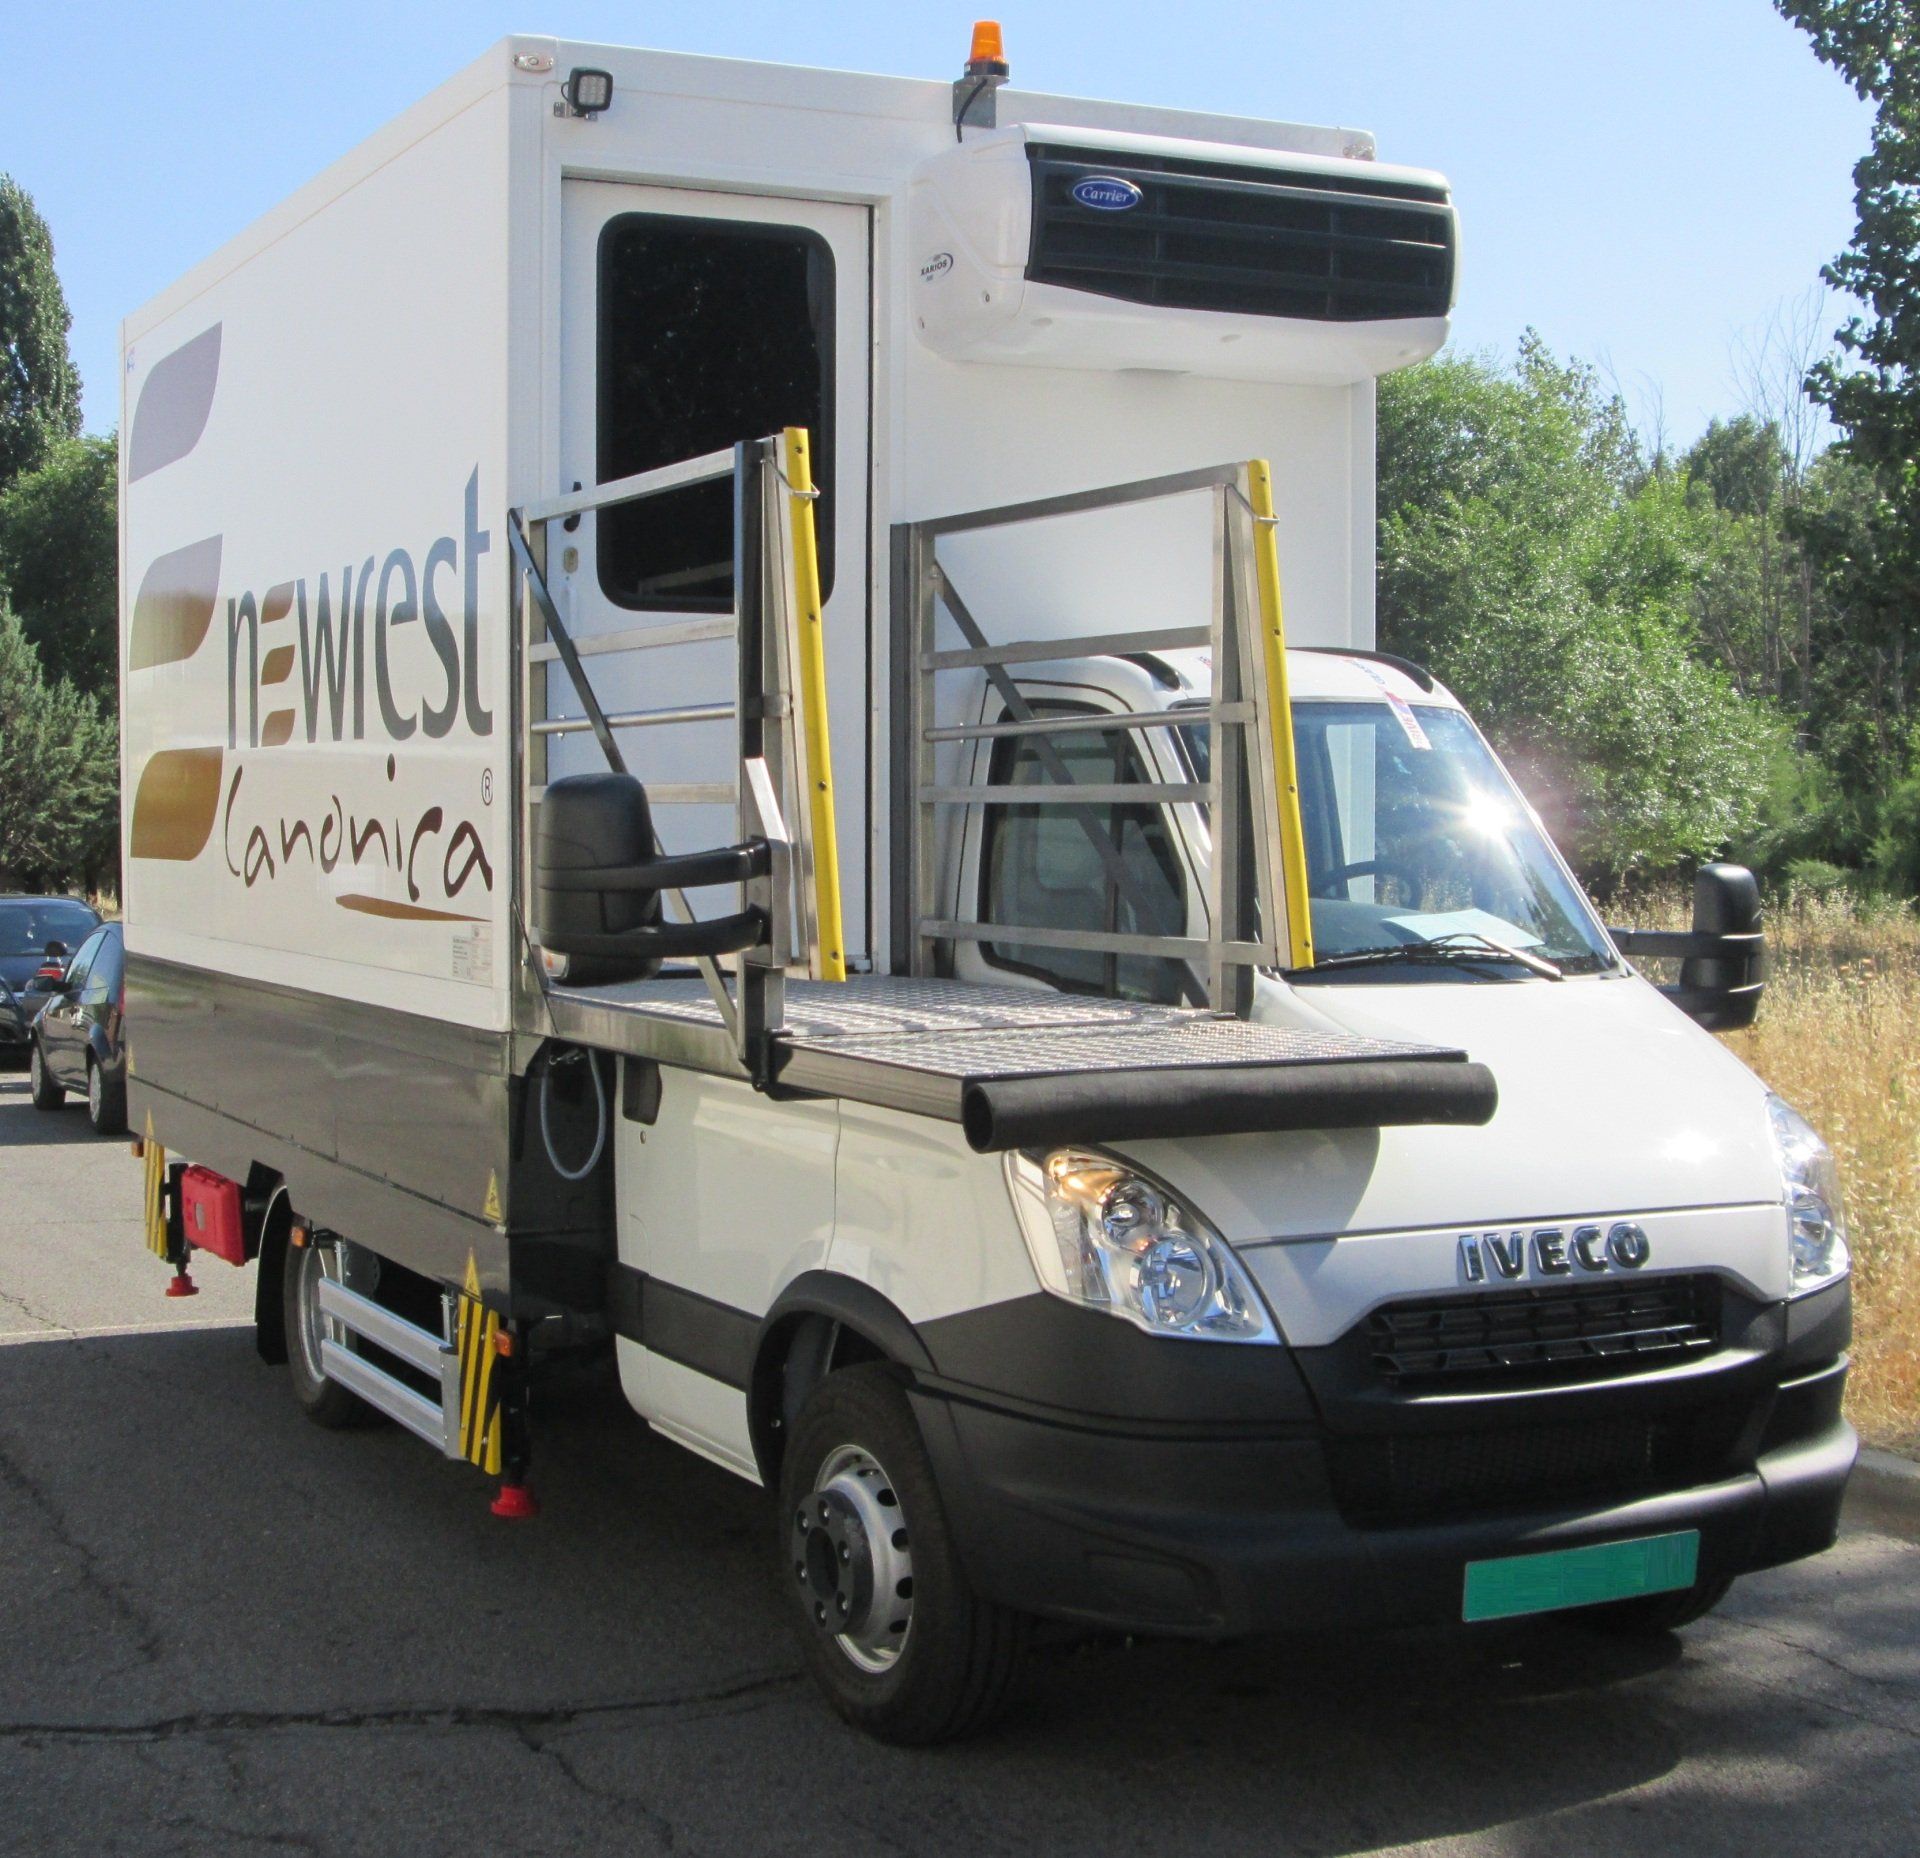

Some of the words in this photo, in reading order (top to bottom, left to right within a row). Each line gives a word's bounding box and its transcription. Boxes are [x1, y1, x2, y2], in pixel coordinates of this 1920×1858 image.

[1082, 186, 1129, 202] Carrier
[228, 462, 492, 750] newrest
[1458, 1222, 1650, 1282] IVECO
